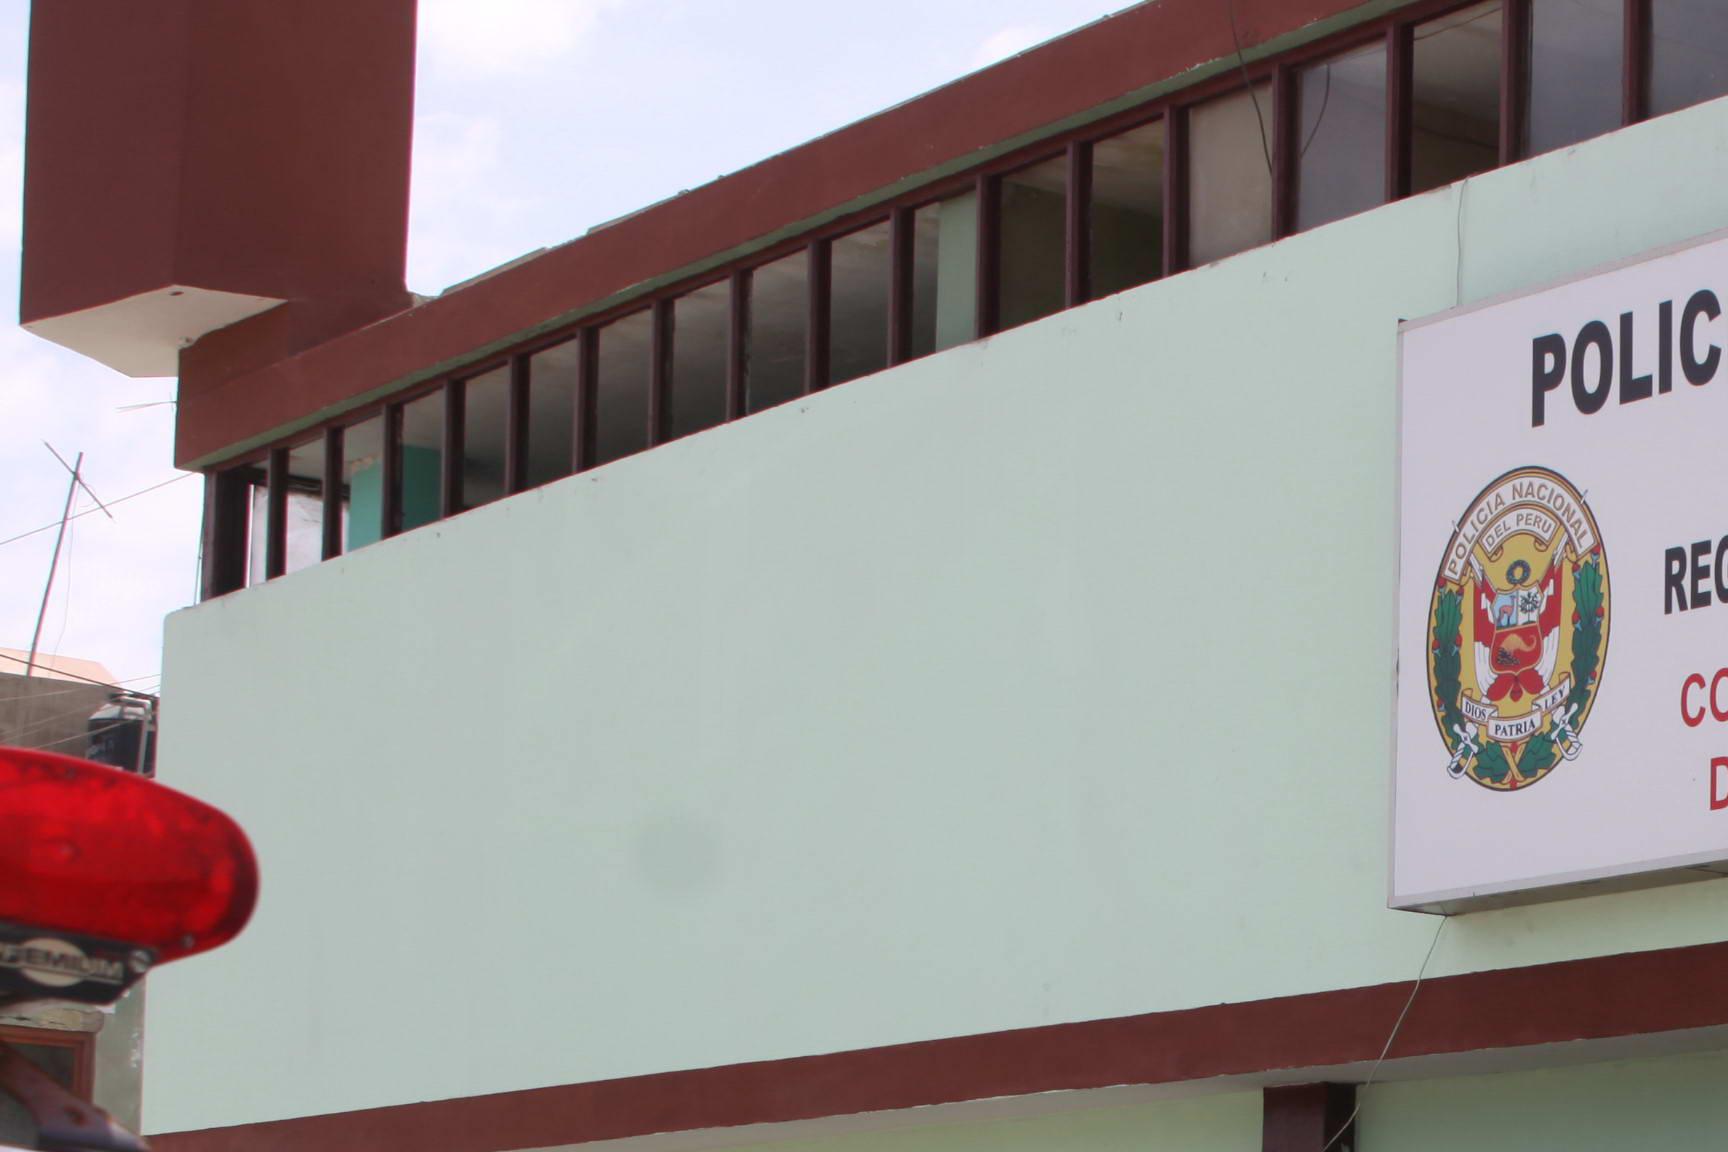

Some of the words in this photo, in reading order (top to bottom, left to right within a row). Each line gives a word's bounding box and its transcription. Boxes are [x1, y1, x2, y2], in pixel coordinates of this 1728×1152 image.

[1448, 492, 1507, 576] POLICIA
[1511, 481, 1588, 550] NACIONAL
[1485, 522, 1511, 548] DEL
[1515, 512, 1552, 535] PERU
[1464, 700, 1488, 720] DIOS
[1494, 719, 1536, 738] PATRIA
